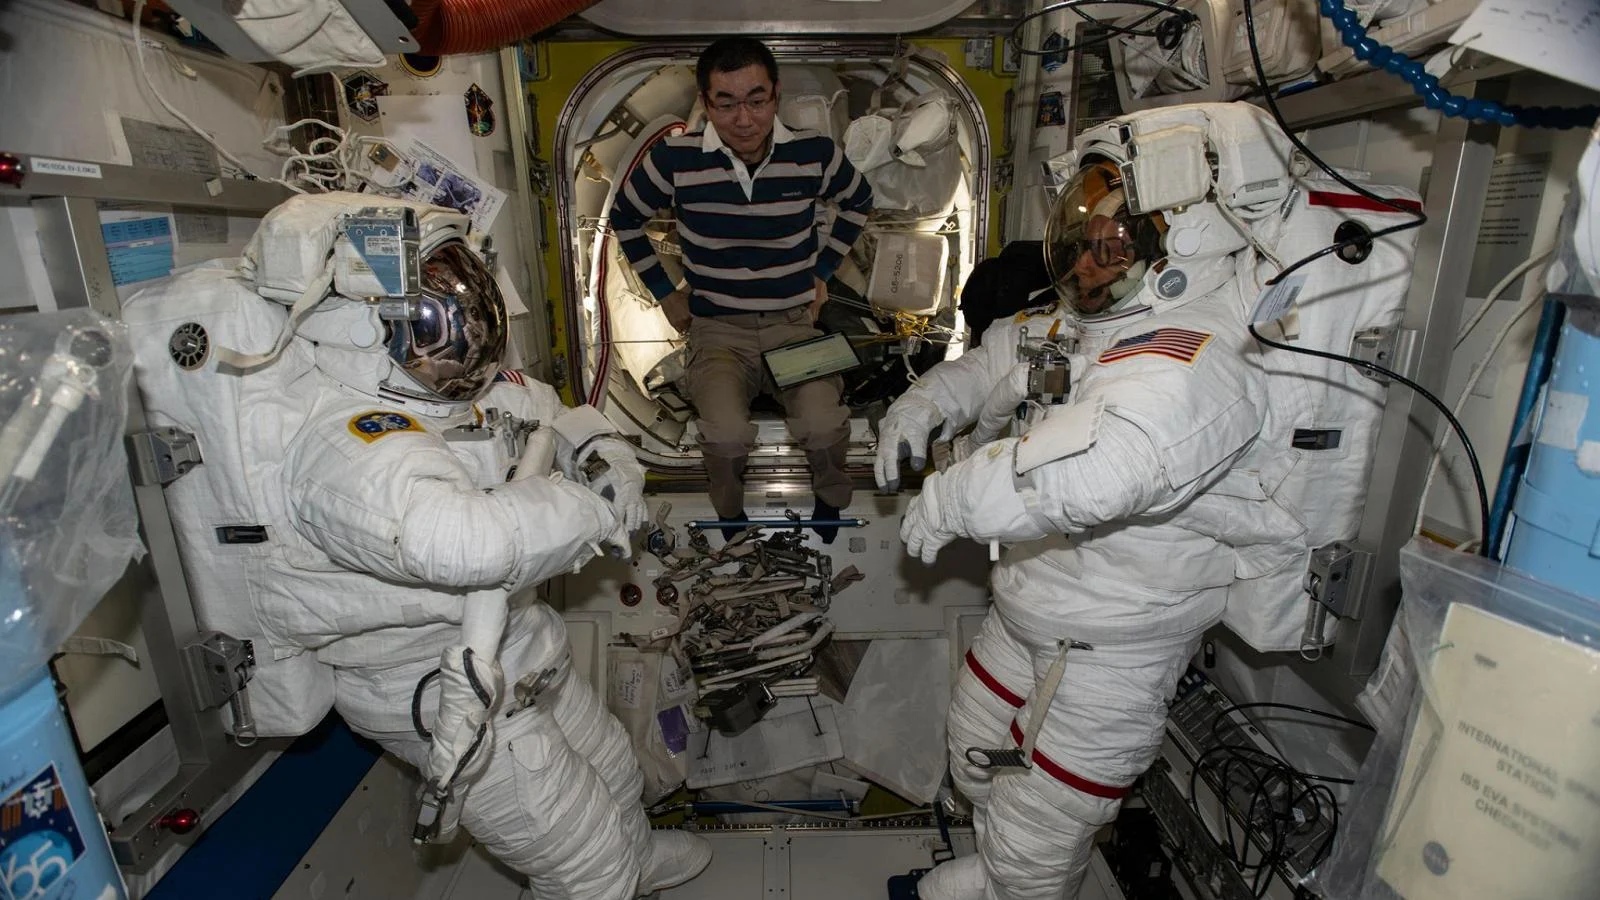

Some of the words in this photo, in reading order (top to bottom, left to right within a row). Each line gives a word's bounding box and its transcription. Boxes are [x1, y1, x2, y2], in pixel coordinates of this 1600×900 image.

[1457, 719, 1559, 782] INTERNATIONAL
[1460, 771, 1481, 792] ISS
[1482, 784, 1509, 809] EVA
[1496, 758, 1556, 799] STATION
